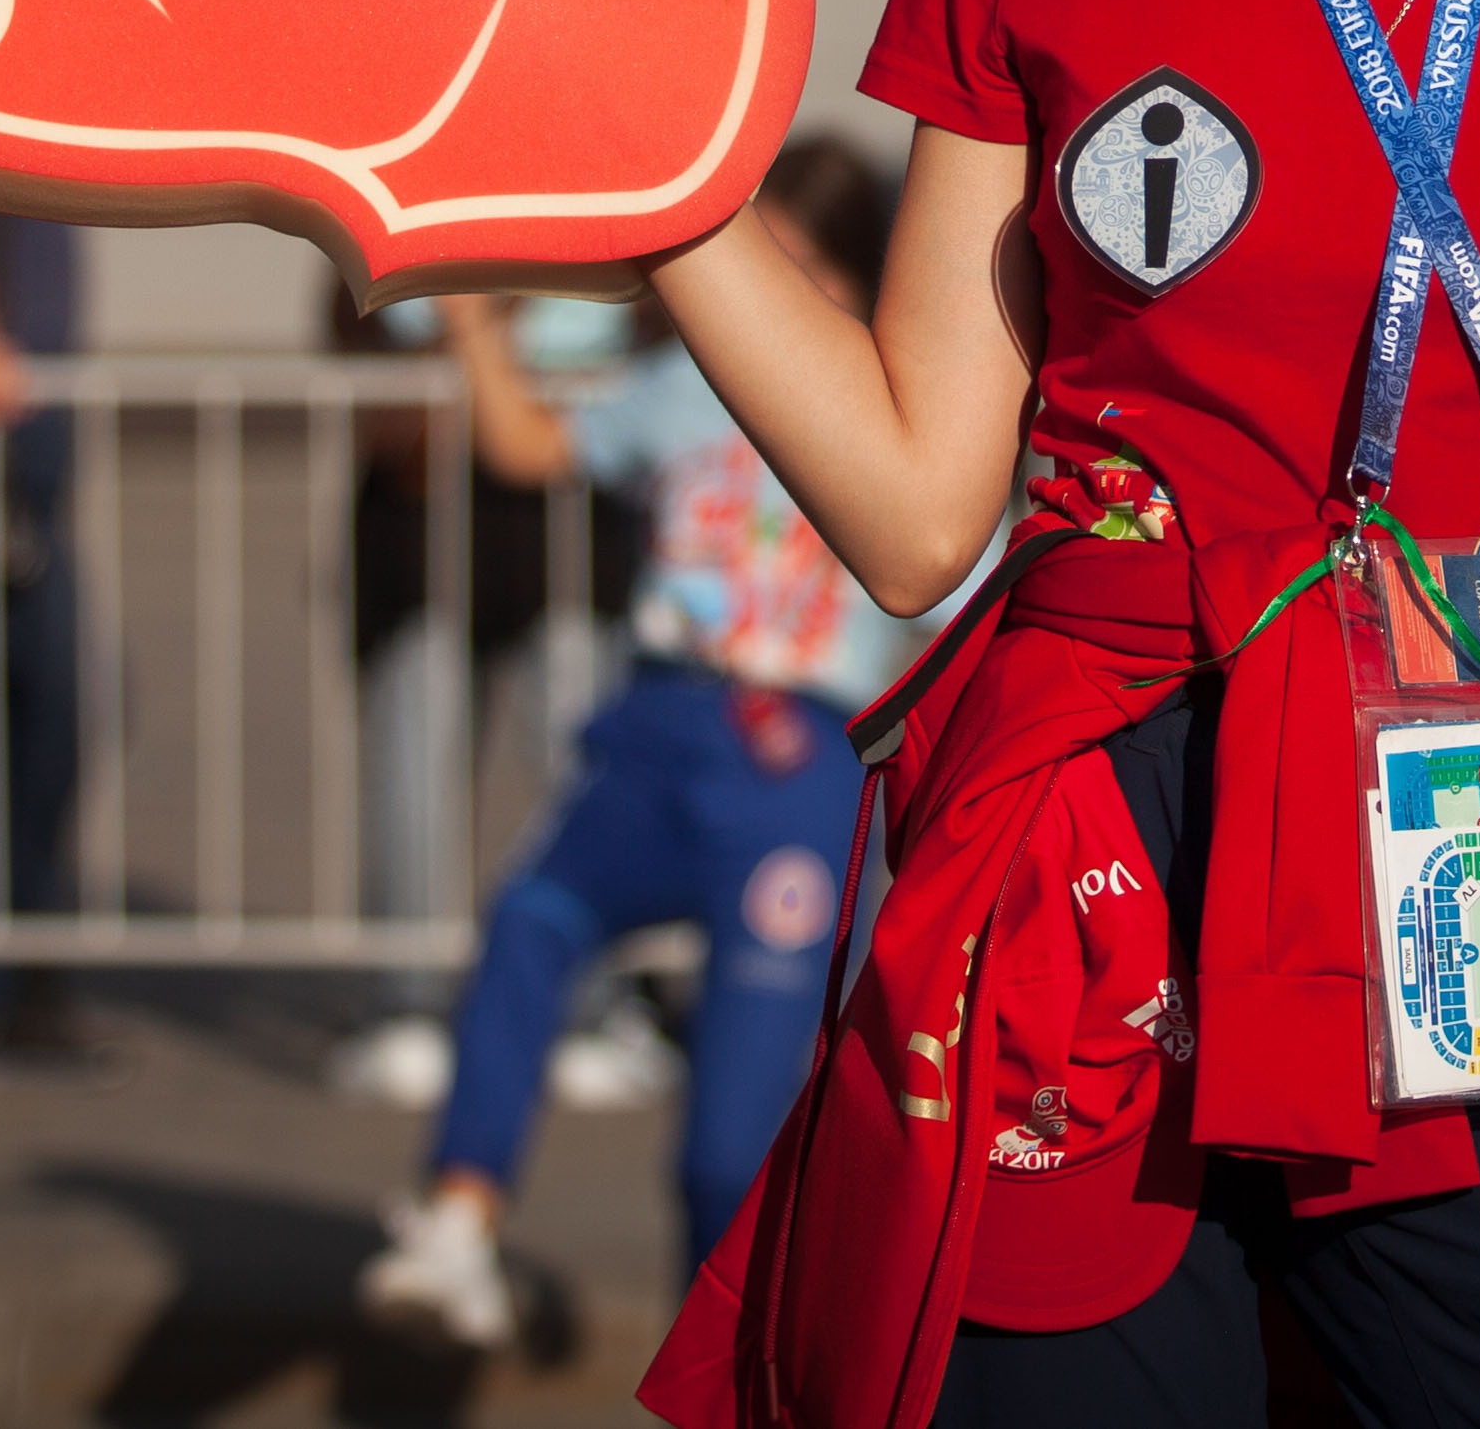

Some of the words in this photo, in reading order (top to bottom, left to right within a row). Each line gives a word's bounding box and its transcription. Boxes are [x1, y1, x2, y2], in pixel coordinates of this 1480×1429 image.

[1358, 50, 1404, 116] 2018
[1462, 885, 1477, 902] TV
[1158, 977, 1196, 1062] adidas
[1007, 1151, 1065, 1170] 2017
